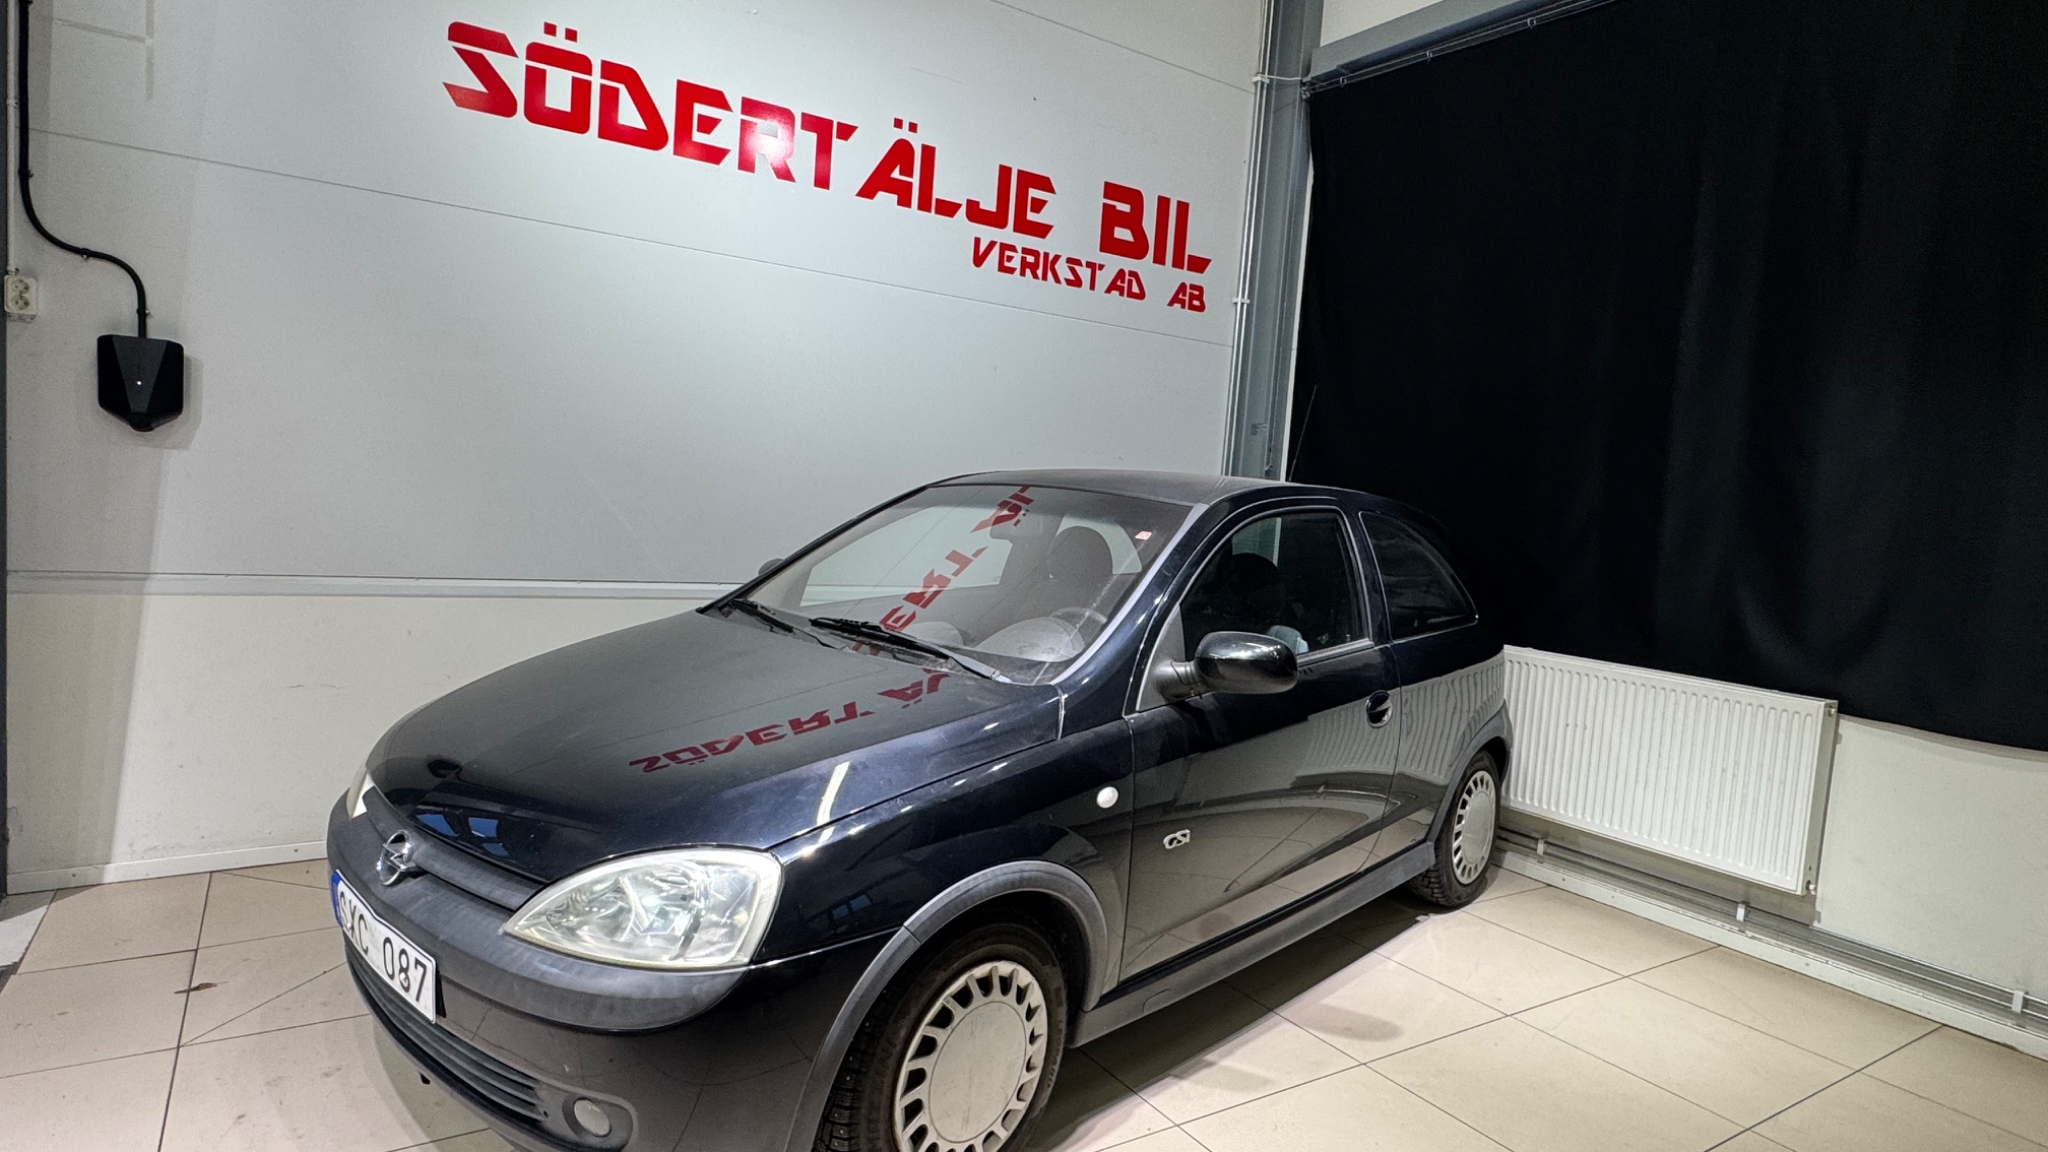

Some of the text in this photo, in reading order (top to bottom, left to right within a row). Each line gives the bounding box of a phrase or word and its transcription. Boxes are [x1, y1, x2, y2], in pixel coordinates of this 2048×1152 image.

[1099, 181, 1212, 275] BIL
[972, 236, 1207, 314] VERKSTAD AB
[383, 936, 427, 1003] 087
